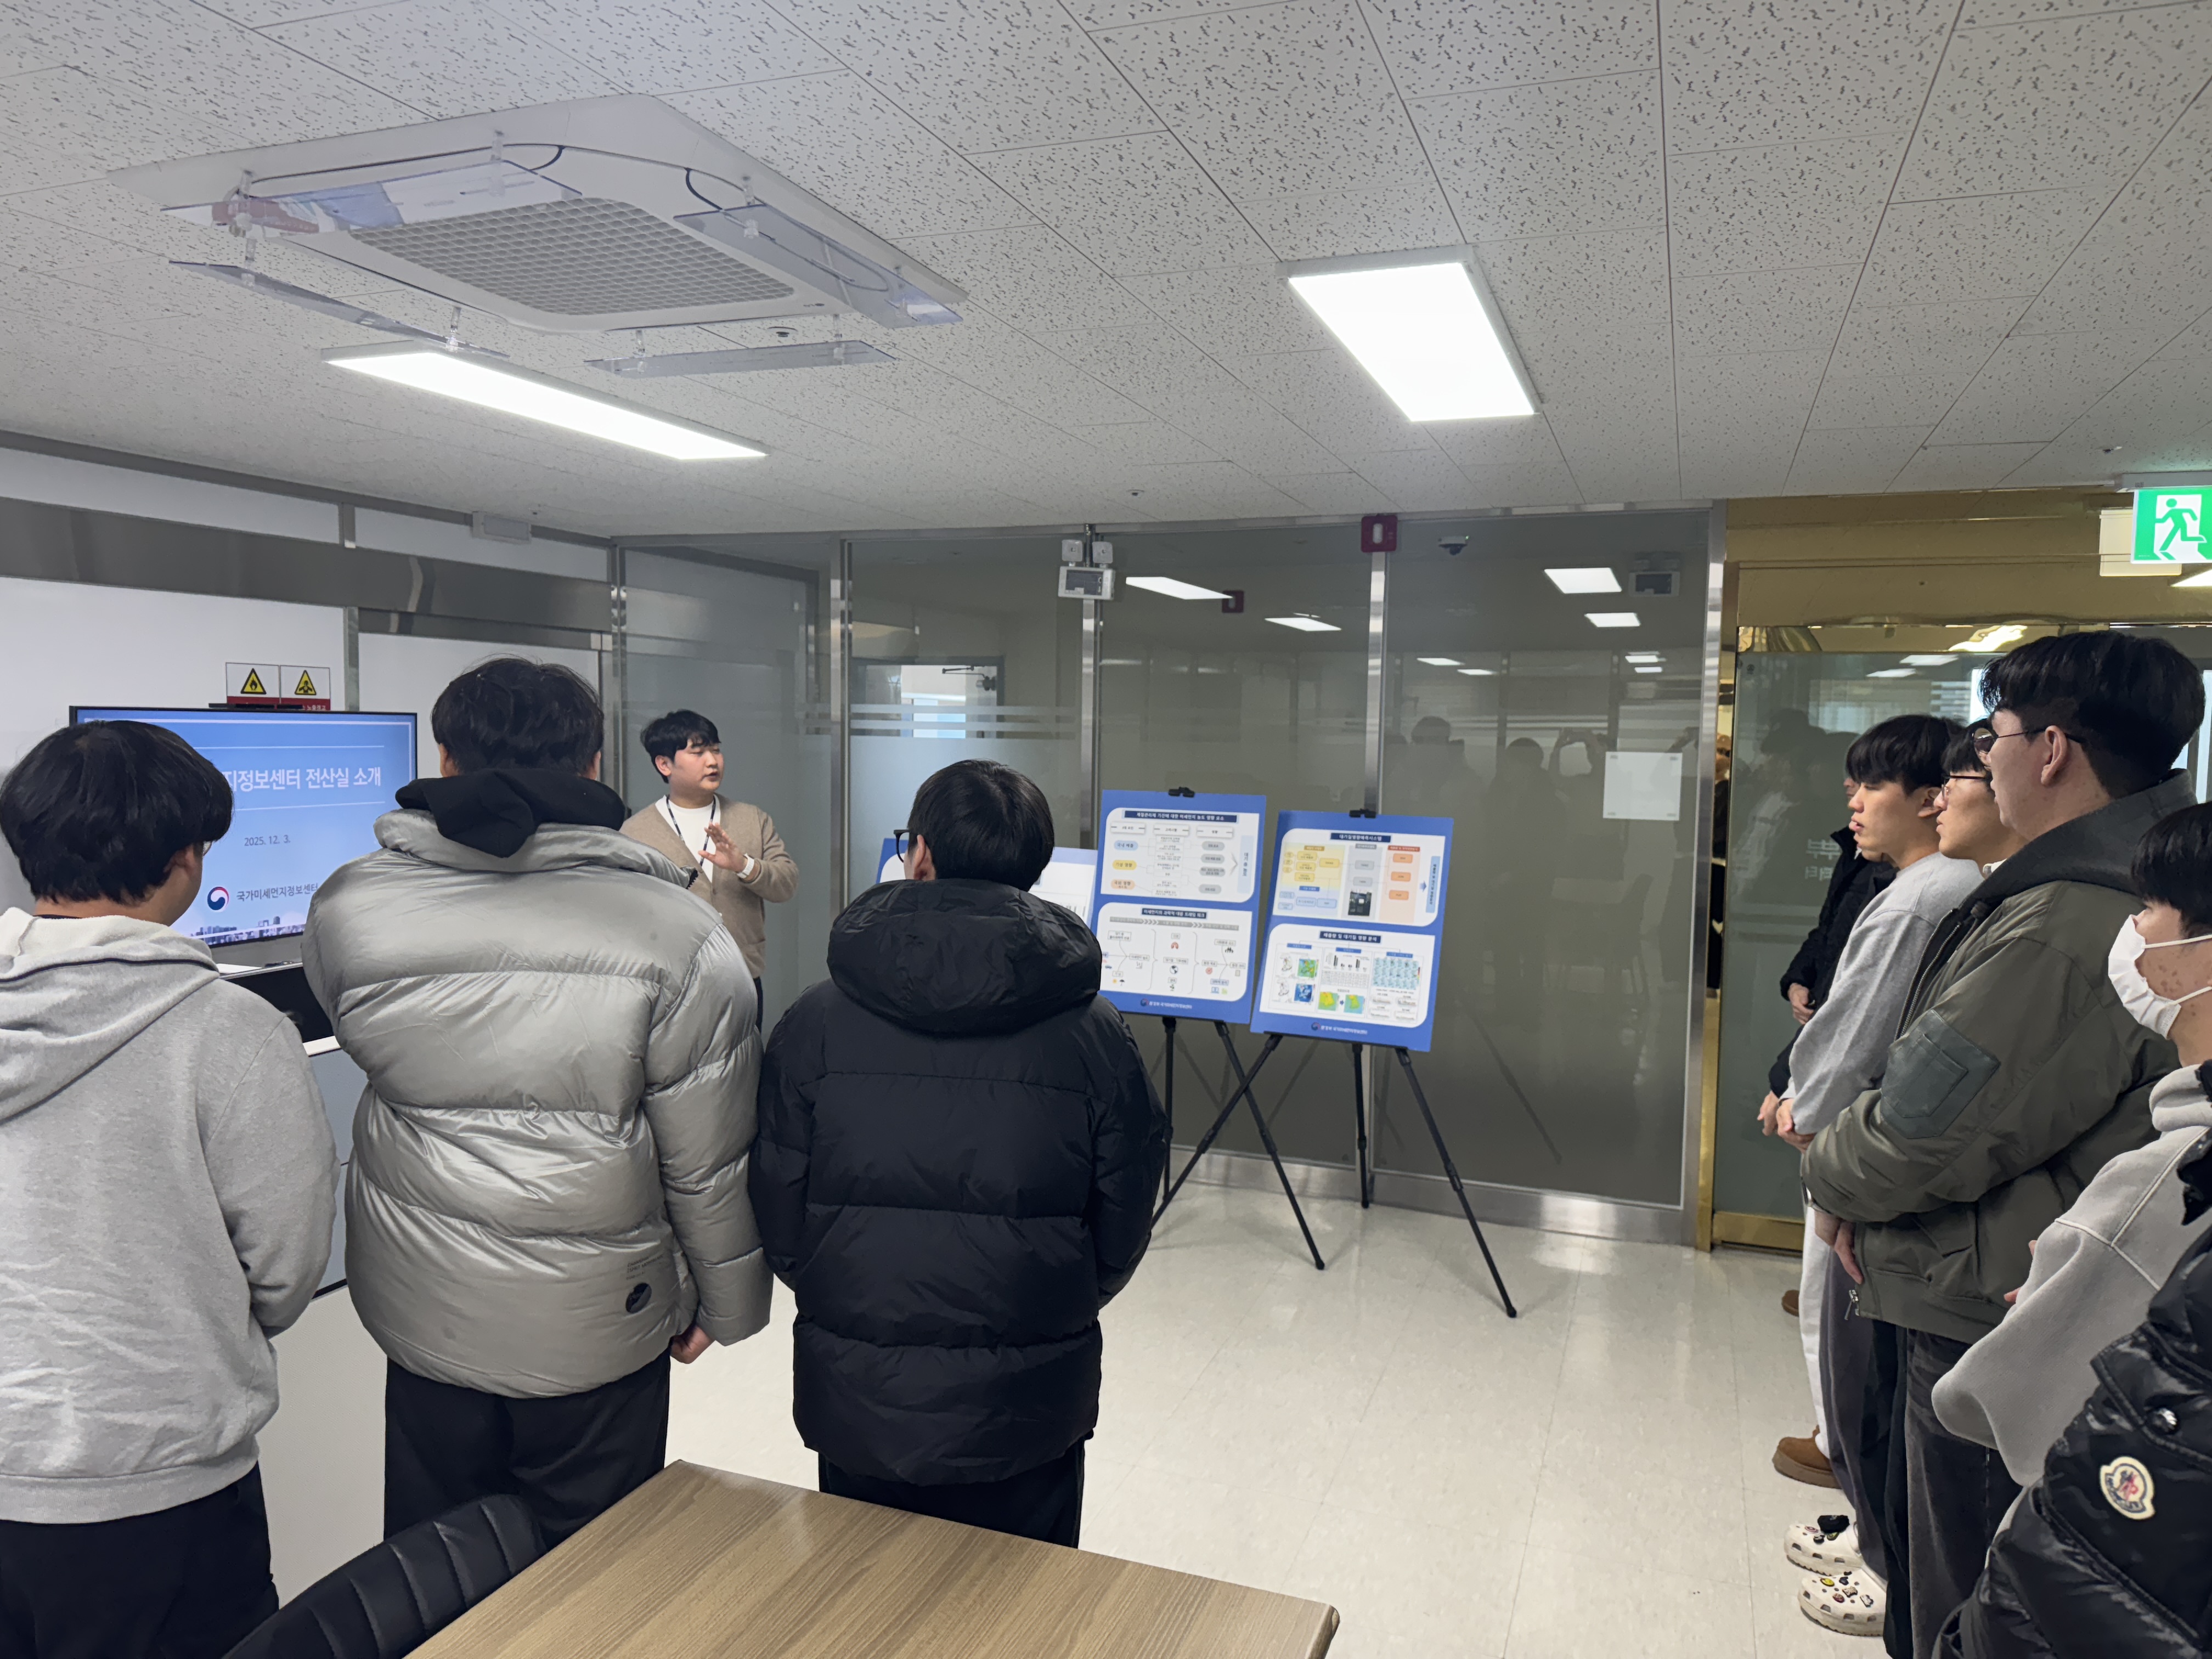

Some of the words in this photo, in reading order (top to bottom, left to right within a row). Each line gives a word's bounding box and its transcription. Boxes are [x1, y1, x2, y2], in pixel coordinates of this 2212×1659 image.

[306, 767, 349, 789] 전산실
[353, 766, 381, 787] 소개
[244, 837, 266, 847] 2025.
[269, 836, 280, 844] 12.
[284, 835, 291, 843] 3.
[236, 883, 318, 902] 국가미세먼지정보센터
